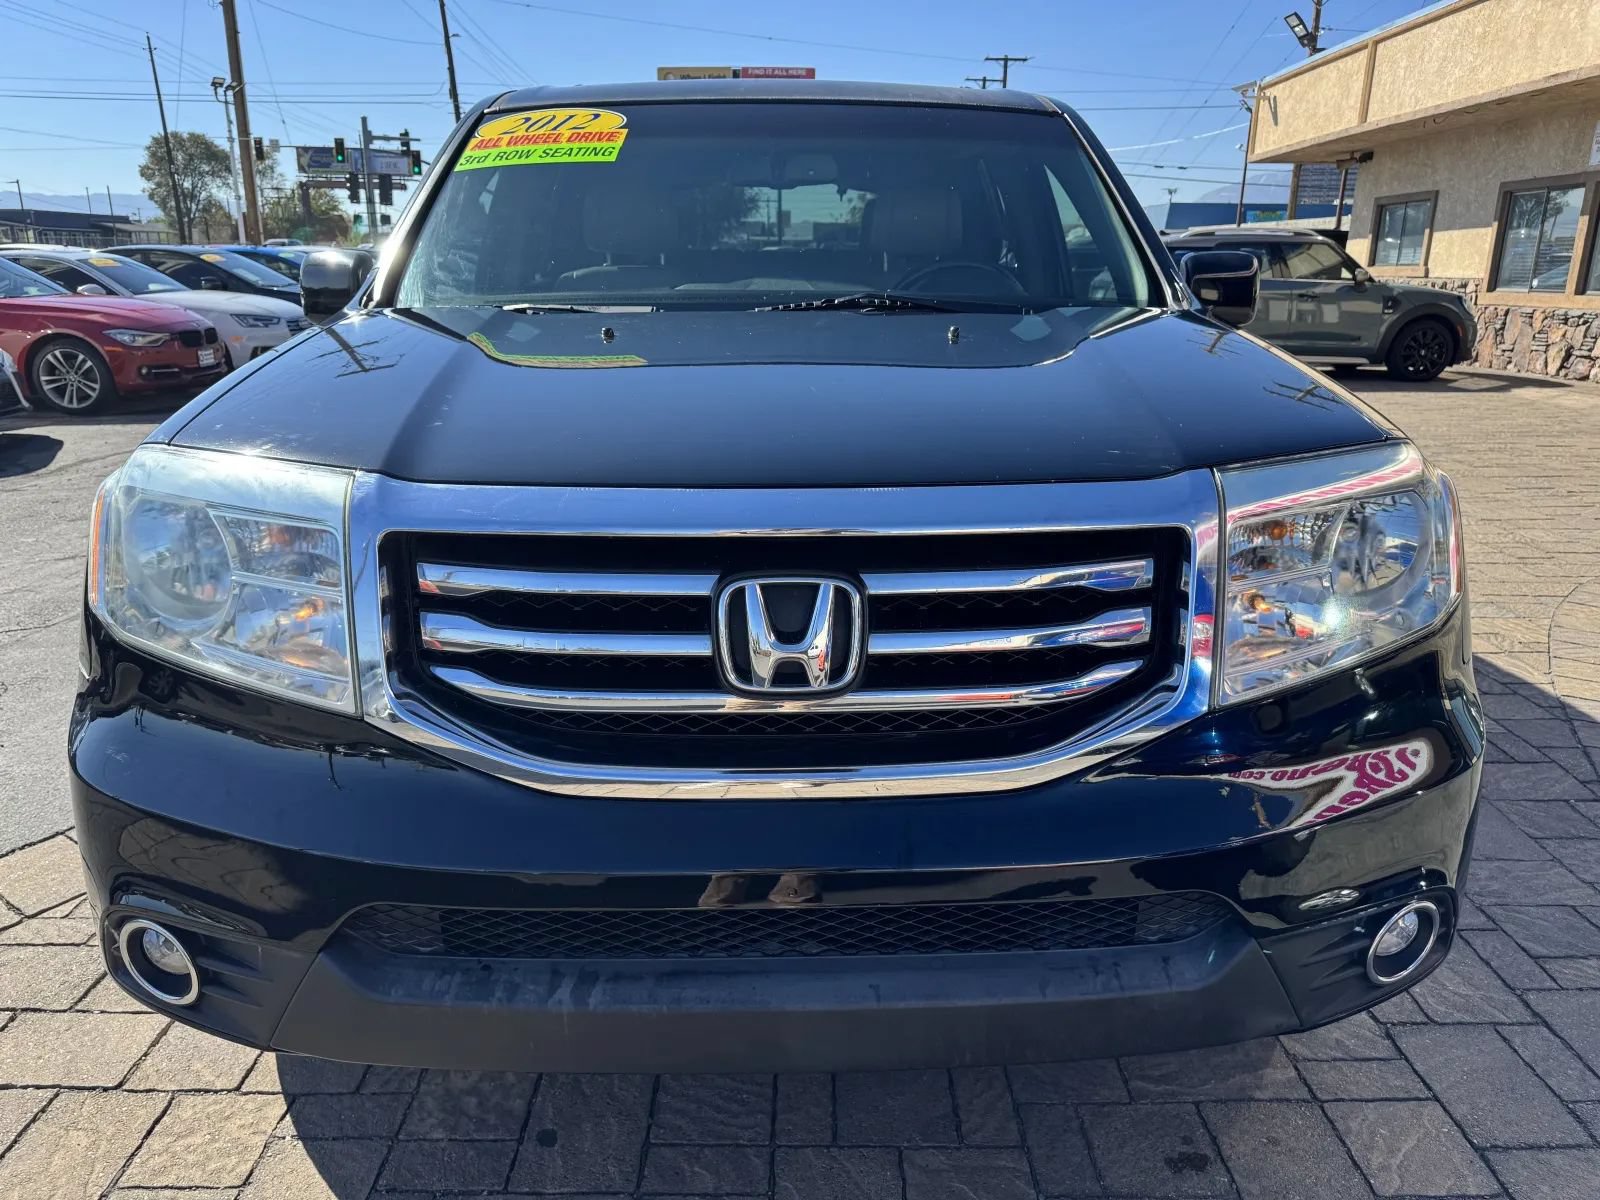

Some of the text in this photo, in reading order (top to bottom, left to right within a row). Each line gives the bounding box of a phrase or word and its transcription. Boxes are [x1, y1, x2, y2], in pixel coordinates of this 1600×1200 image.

[773, 68, 787, 76] ALL
[499, 113, 601, 135] 2012
[472, 131, 621, 151] ALL WHEEL DRIVE
[459, 146, 616, 166] 3rd ROW SEATING
